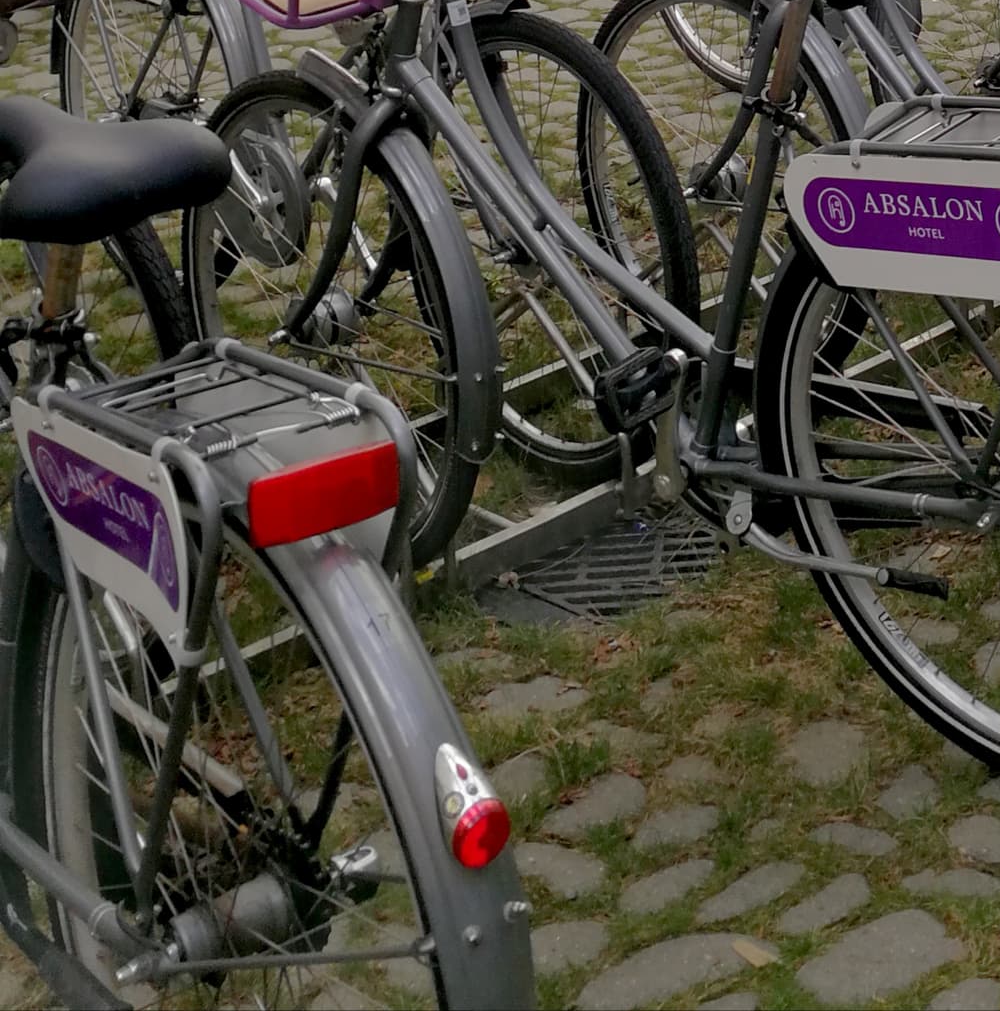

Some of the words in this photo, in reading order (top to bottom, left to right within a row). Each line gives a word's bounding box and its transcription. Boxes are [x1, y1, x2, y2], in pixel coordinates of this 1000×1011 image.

[864, 192, 984, 222] ABSALON
[908, 226, 945, 239] HOTEL
[65, 461, 151, 531] ABSALON
